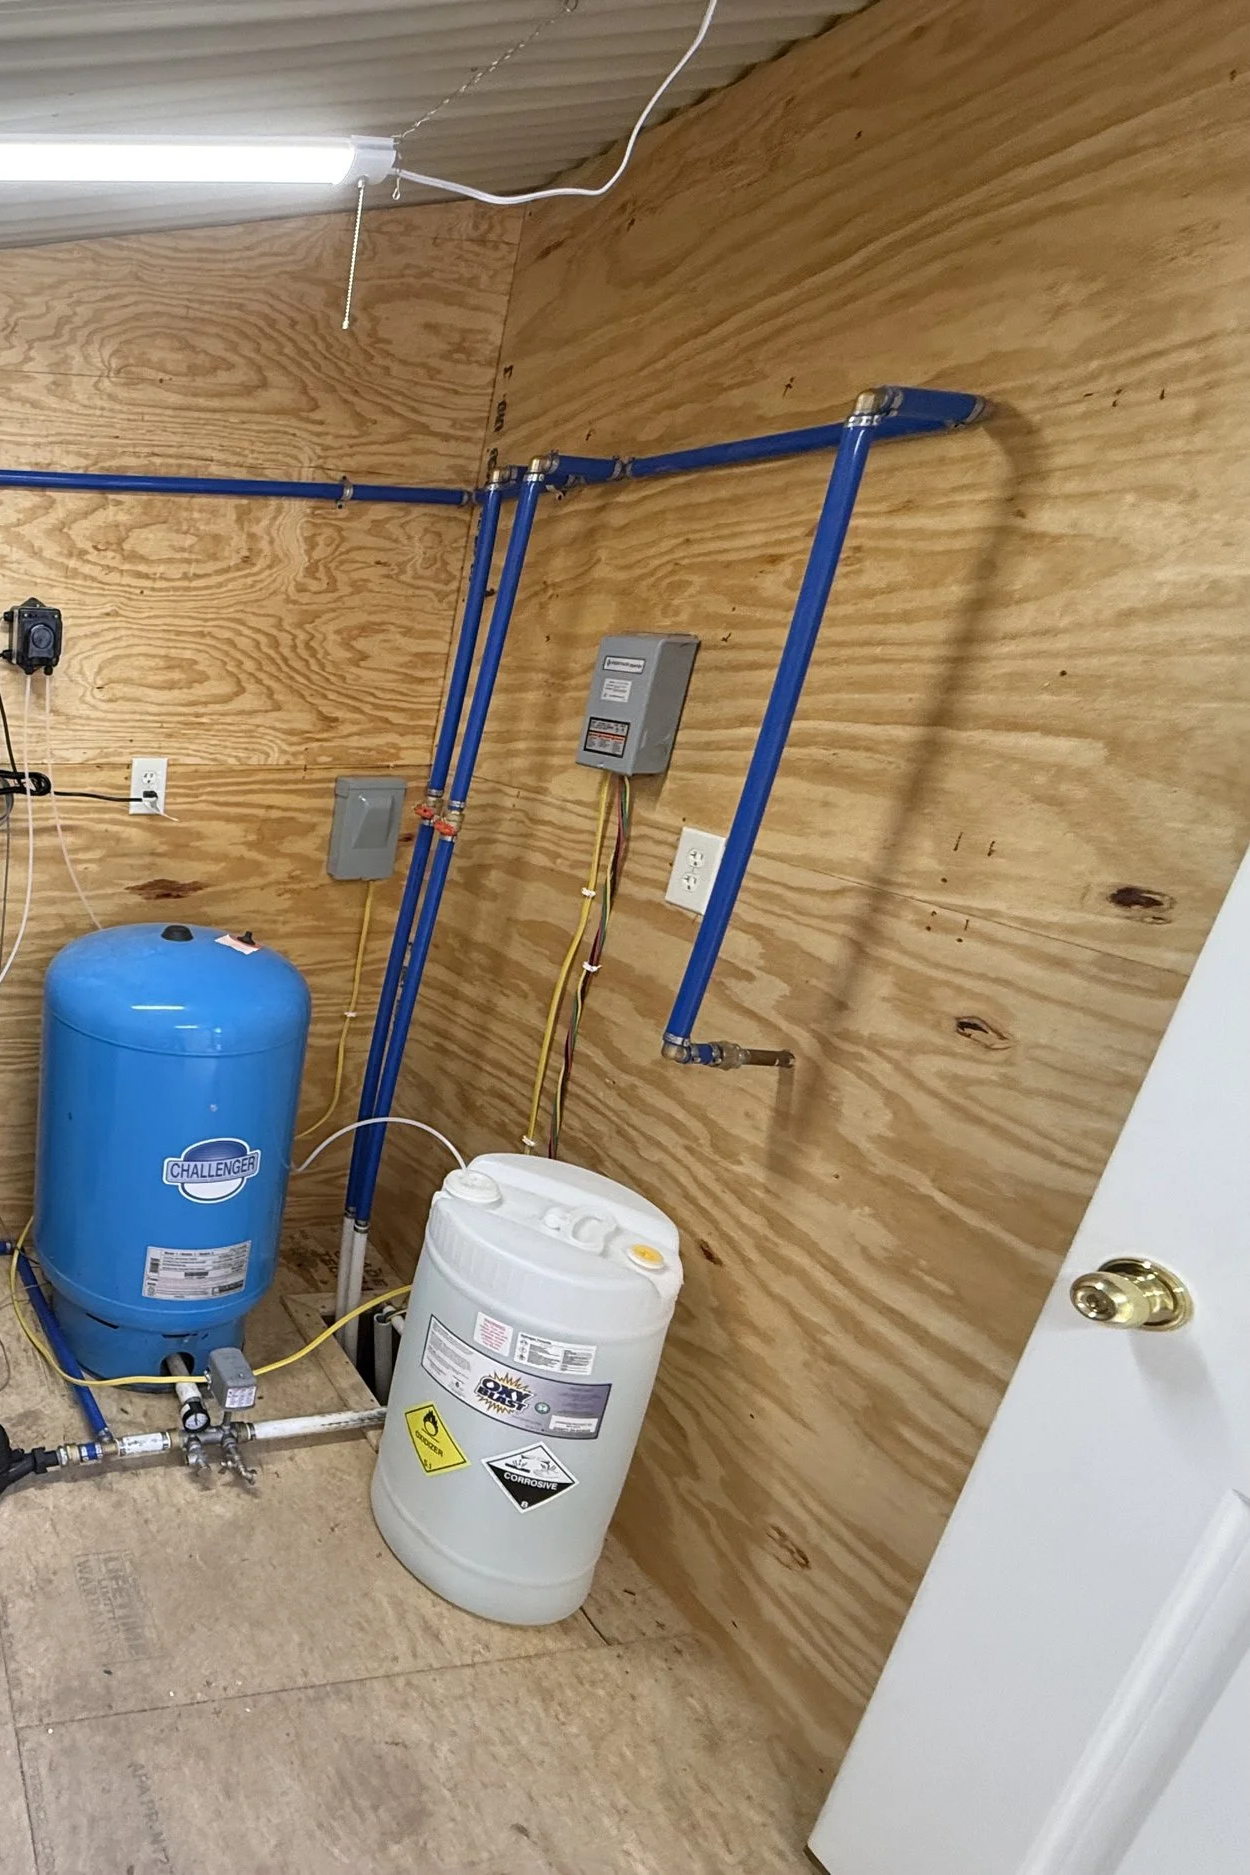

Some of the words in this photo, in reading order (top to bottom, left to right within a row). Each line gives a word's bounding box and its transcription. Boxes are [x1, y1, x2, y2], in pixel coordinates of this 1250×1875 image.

[170, 1155, 256, 1179] CHALLENGER
[476, 1386, 527, 1411] BLAST
[481, 1378, 533, 1404] OXY
[415, 1430, 443, 1457] OXIDIZER
[503, 1472, 559, 1490] CORROSIVE
